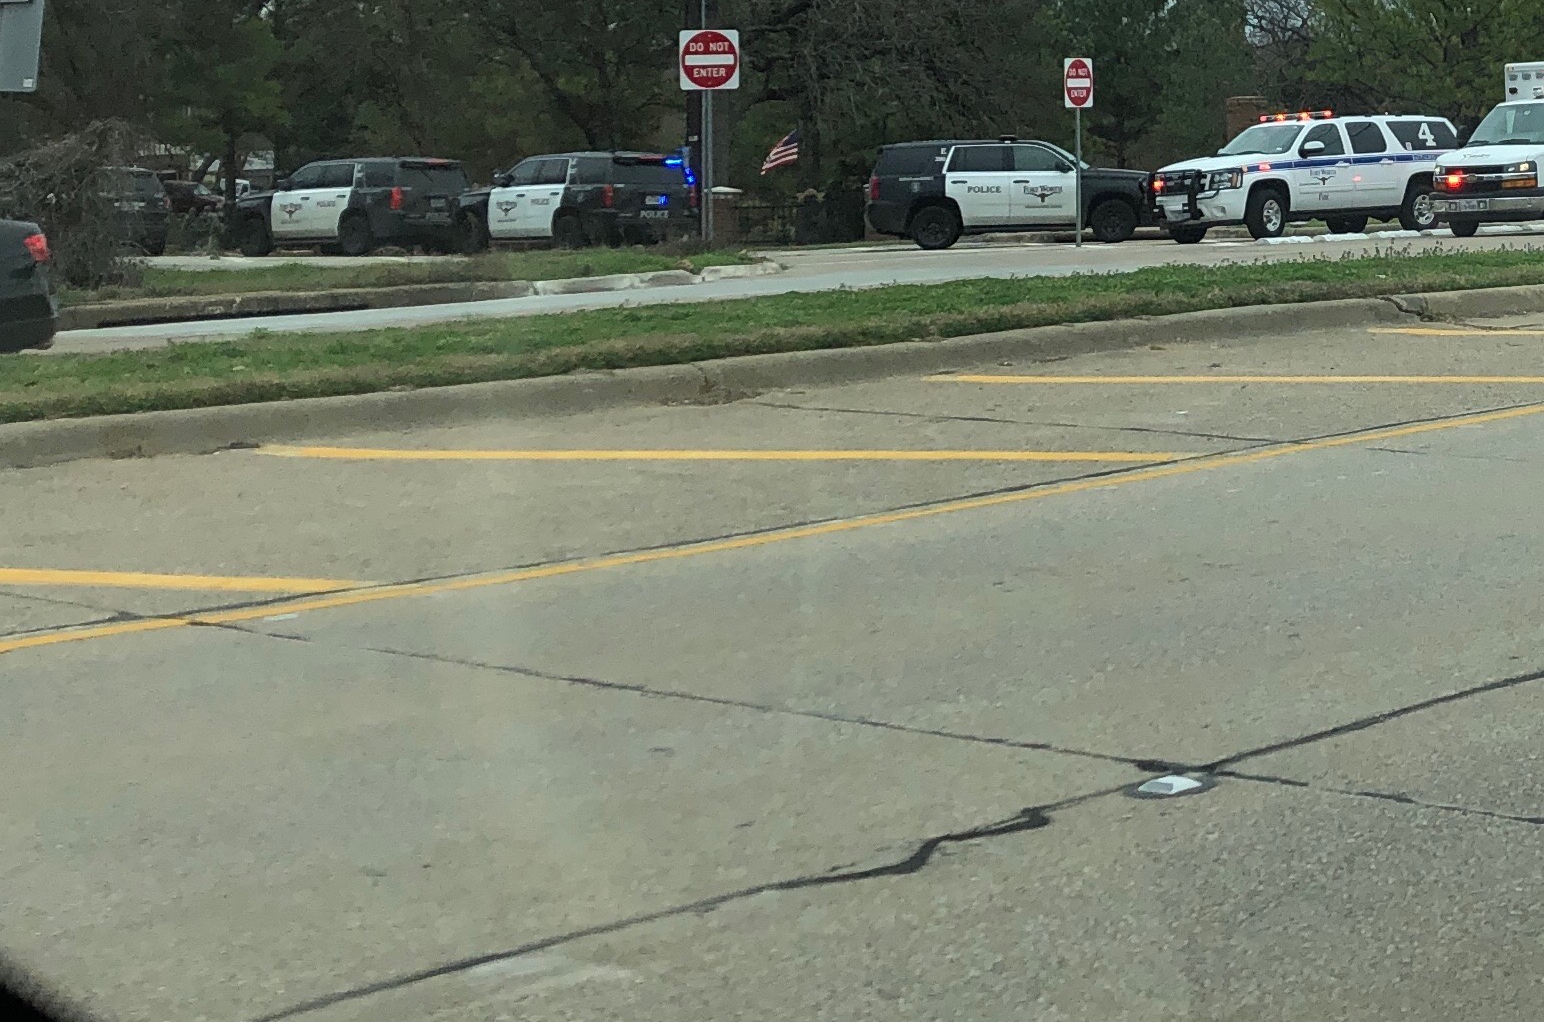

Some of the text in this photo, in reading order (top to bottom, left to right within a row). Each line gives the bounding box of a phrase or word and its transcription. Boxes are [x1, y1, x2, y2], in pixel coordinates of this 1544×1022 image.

[690, 41, 729, 52] DO NOT
[693, 68, 726, 78] ENTER
[1418, 122, 1437, 147] 4
[967, 185, 1002, 194] POLICE
[640, 210, 669, 219] POLICE
